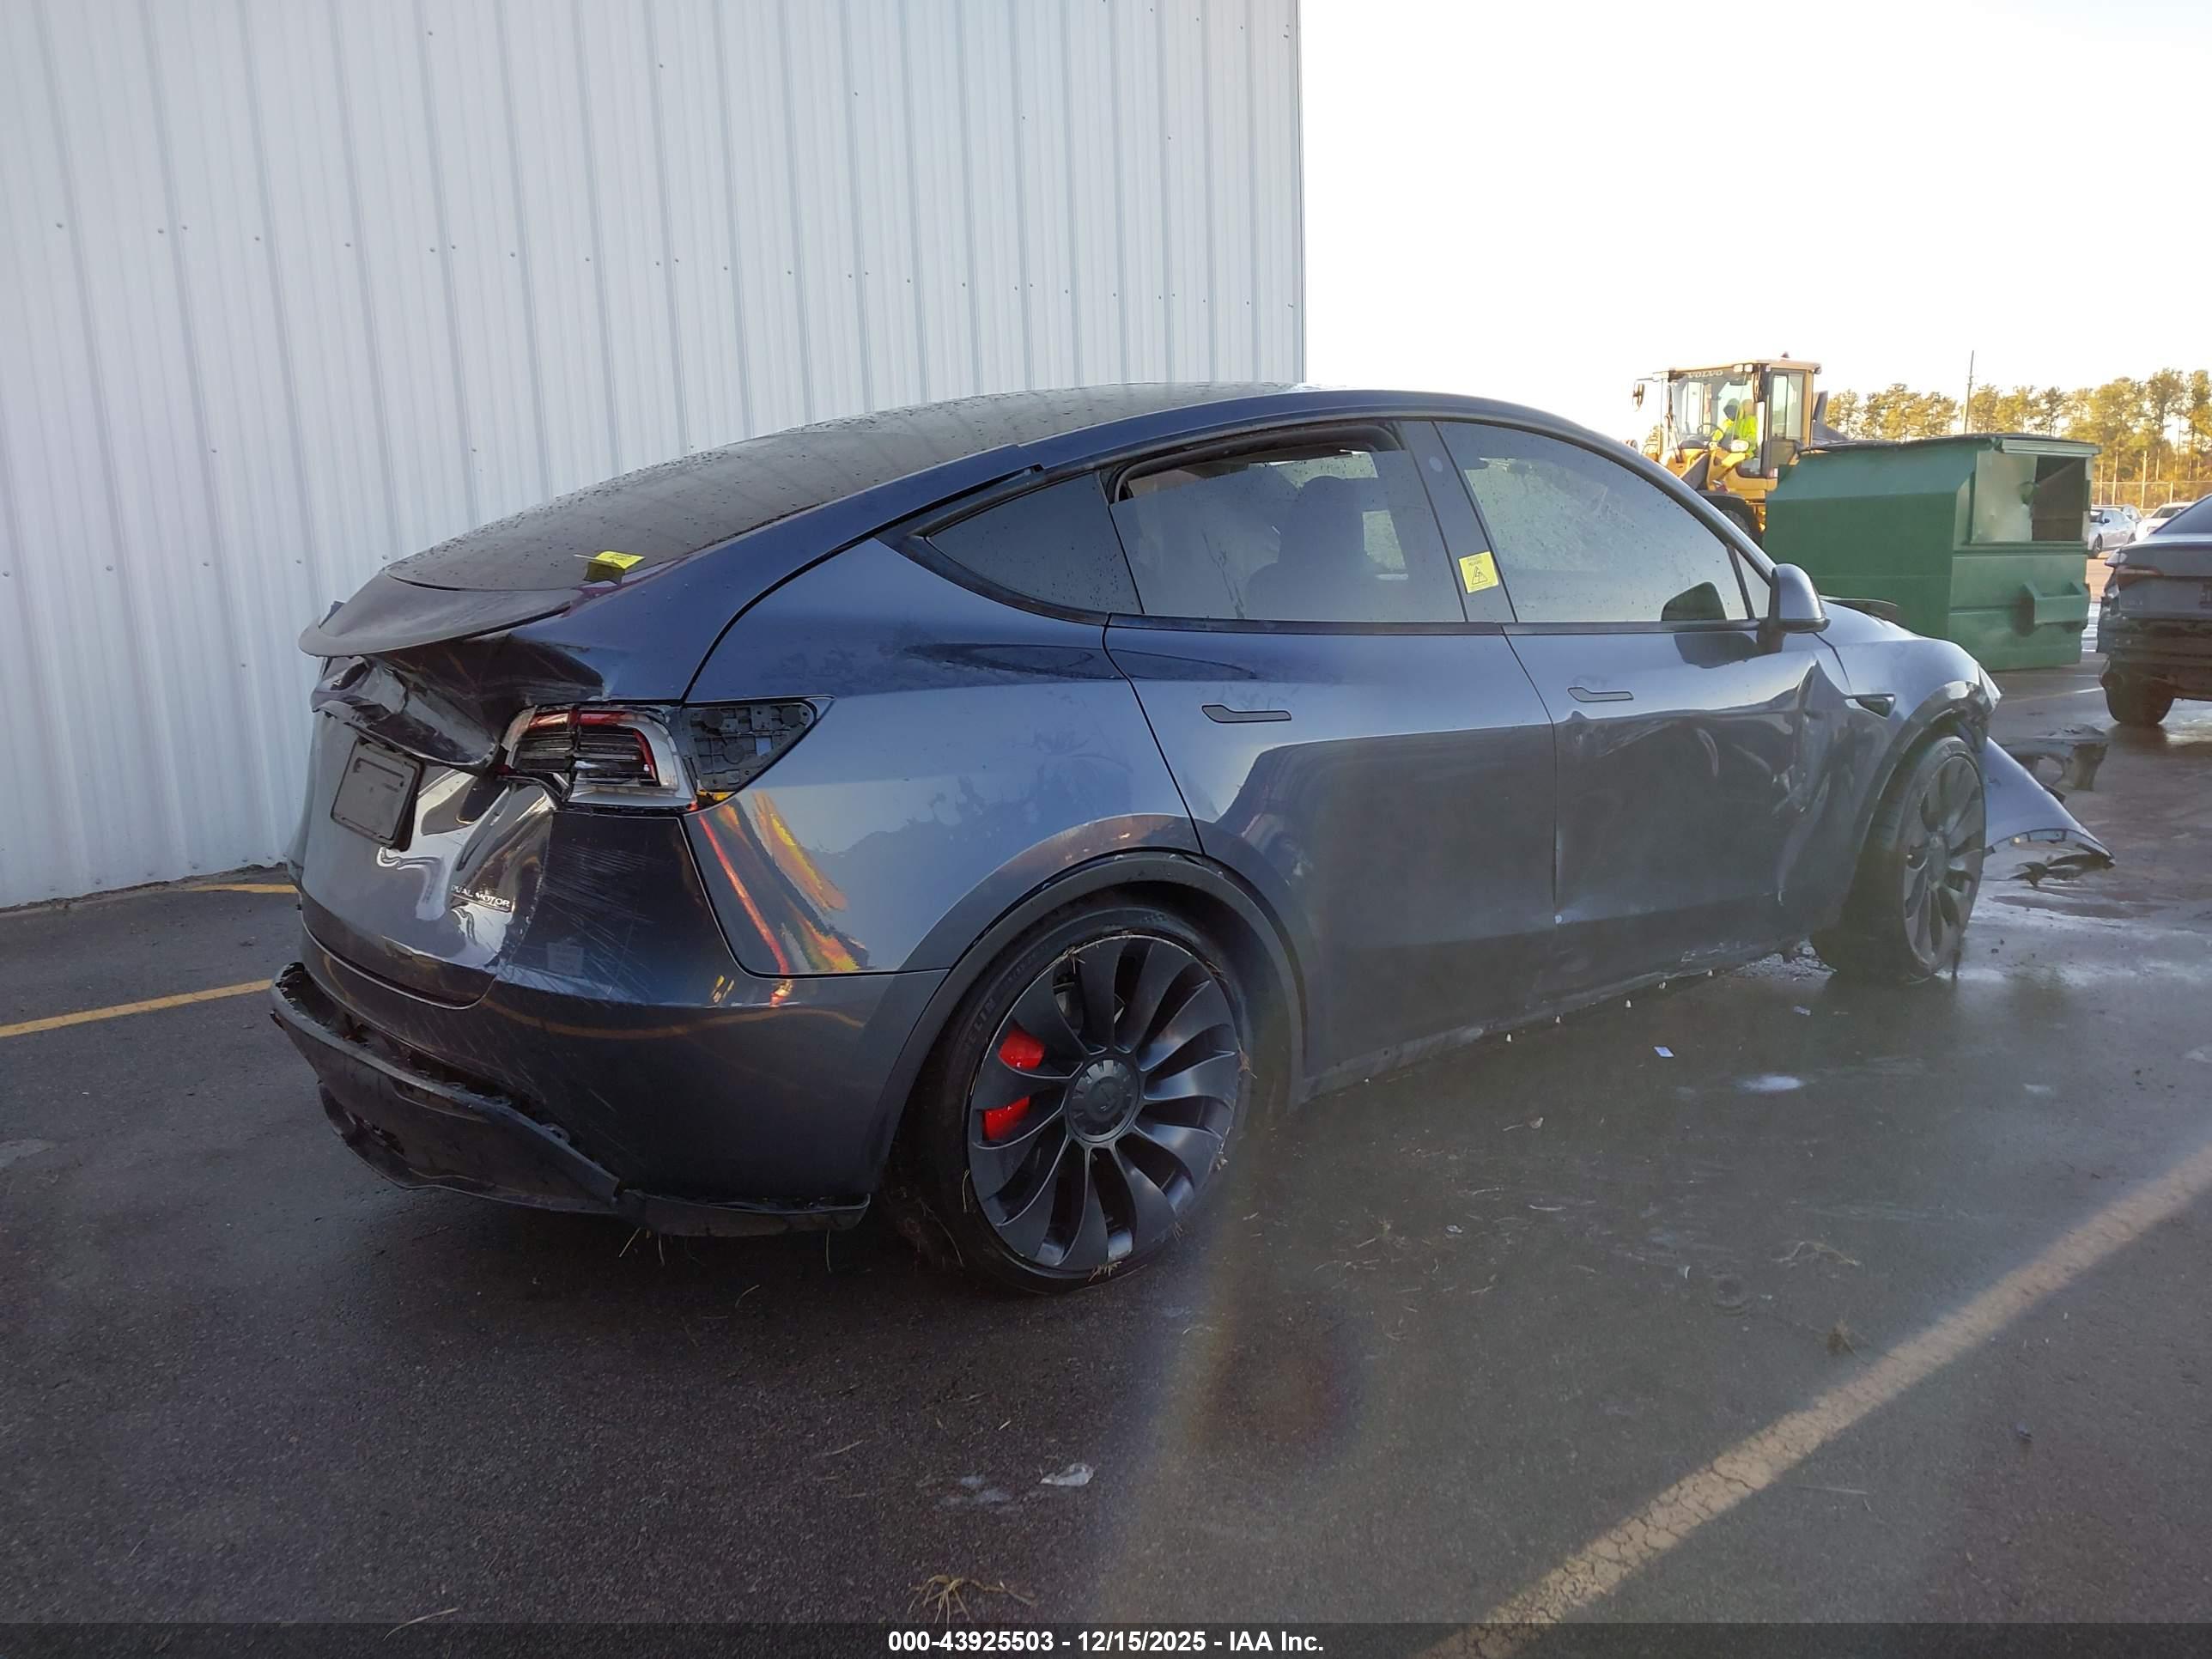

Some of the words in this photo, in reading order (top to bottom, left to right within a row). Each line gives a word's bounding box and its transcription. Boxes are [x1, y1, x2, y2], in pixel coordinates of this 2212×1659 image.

[1687, 369, 1723, 379] VOLVO
[451, 884, 474, 897] DUAL
[475, 891, 511, 908] MOTOR
